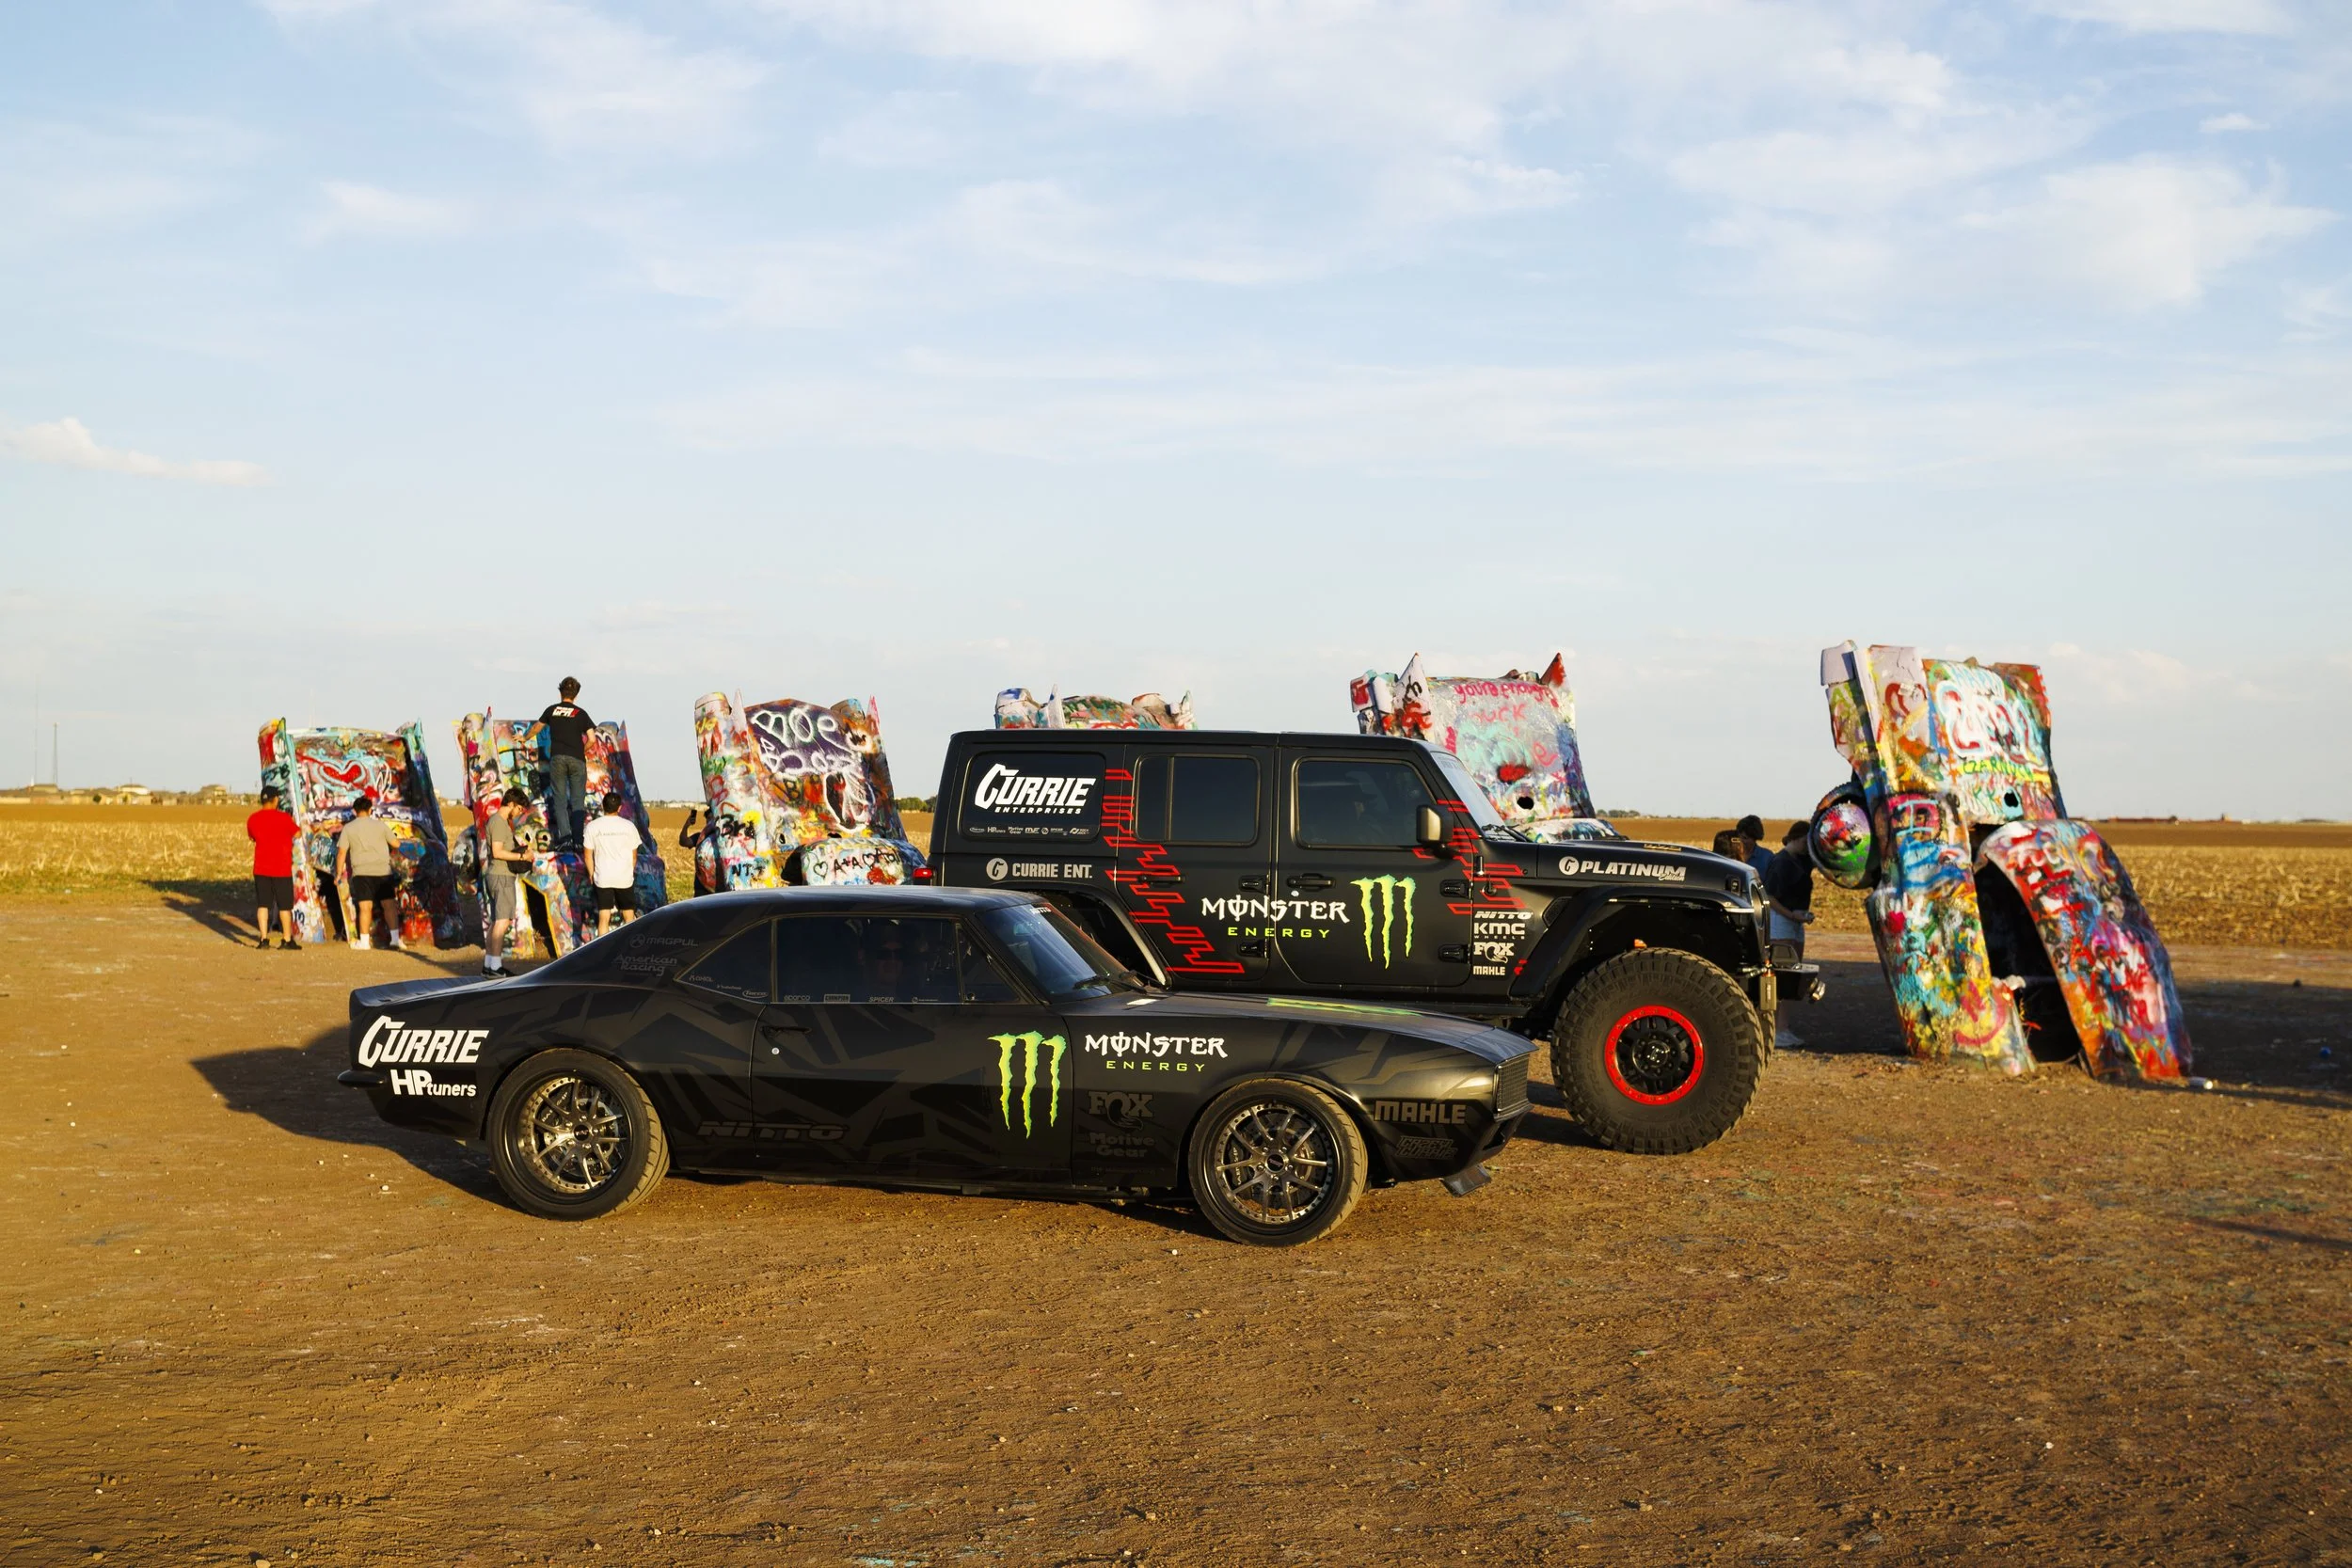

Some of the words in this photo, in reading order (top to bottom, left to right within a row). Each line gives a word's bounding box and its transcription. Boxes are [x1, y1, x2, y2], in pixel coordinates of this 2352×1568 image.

[975, 763, 1096, 809] CURRIE
[994, 806, 1081, 815] ENTERPRISES
[1012, 863, 1059, 879] CURRIE
[1064, 863, 1093, 879] ENT.
[1581, 860, 1686, 879] PLATINUM
[1201, 894, 1350, 924] MONSTER
[1474, 911, 1532, 920] NITTO
[1228, 927, 1329, 939] ENERGY
[1473, 923, 1525, 935] KMC
[1473, 942, 1515, 961] FOX
[612, 954, 677, 966] American
[621, 962, 666, 976] Racing
[1472, 966, 1506, 976] MAHLE
[358, 1015, 489, 1068] CURRIE
[1085, 1032, 1228, 1058] MONSTER
[1105, 1060, 1205, 1072] ENERGY
[1088, 1091, 1155, 1127] FOX
[1375, 1101, 1466, 1124] MAHLE
[696, 1120, 847, 1141] NITTO
[1089, 1132, 1155, 1147] Motive
[1096, 1145, 1148, 1158] Gear
